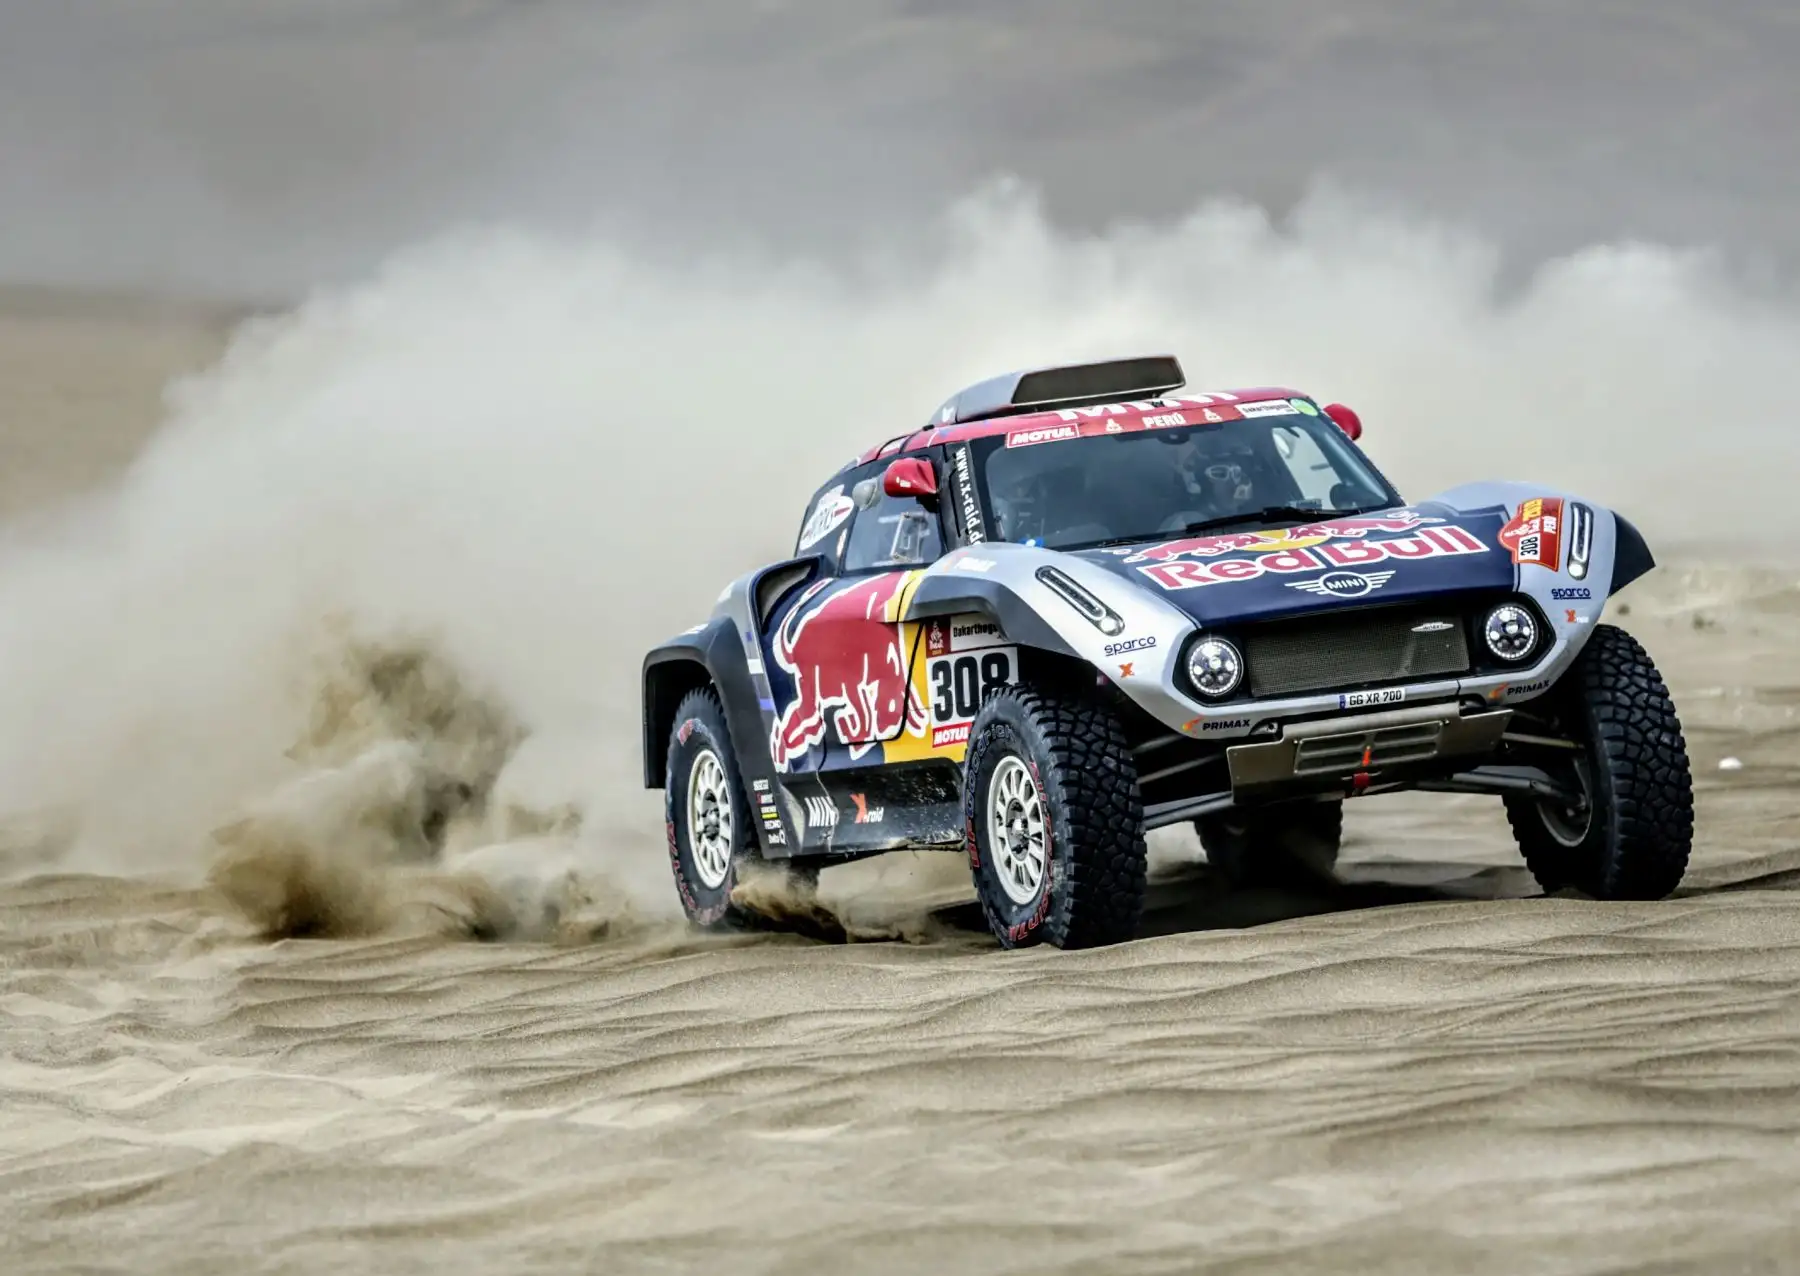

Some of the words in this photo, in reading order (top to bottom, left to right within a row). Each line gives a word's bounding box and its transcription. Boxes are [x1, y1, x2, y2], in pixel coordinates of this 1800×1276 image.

[1011, 427, 1075, 445] MOTUL
[1520, 536, 1538, 556] 308
[1138, 547, 1325, 590] Red
[1314, 525, 1491, 567] Bull
[1326, 577, 1364, 590] MINI
[1551, 588, 1591, 600] sparco
[1104, 636, 1156, 656] sparco
[932, 652, 1010, 722] 308
[1507, 680, 1550, 696] PRIMAX
[1349, 695, 1363, 706] GG
[1366, 692, 1380, 704] XR
[1203, 719, 1250, 731] PRIMAX
